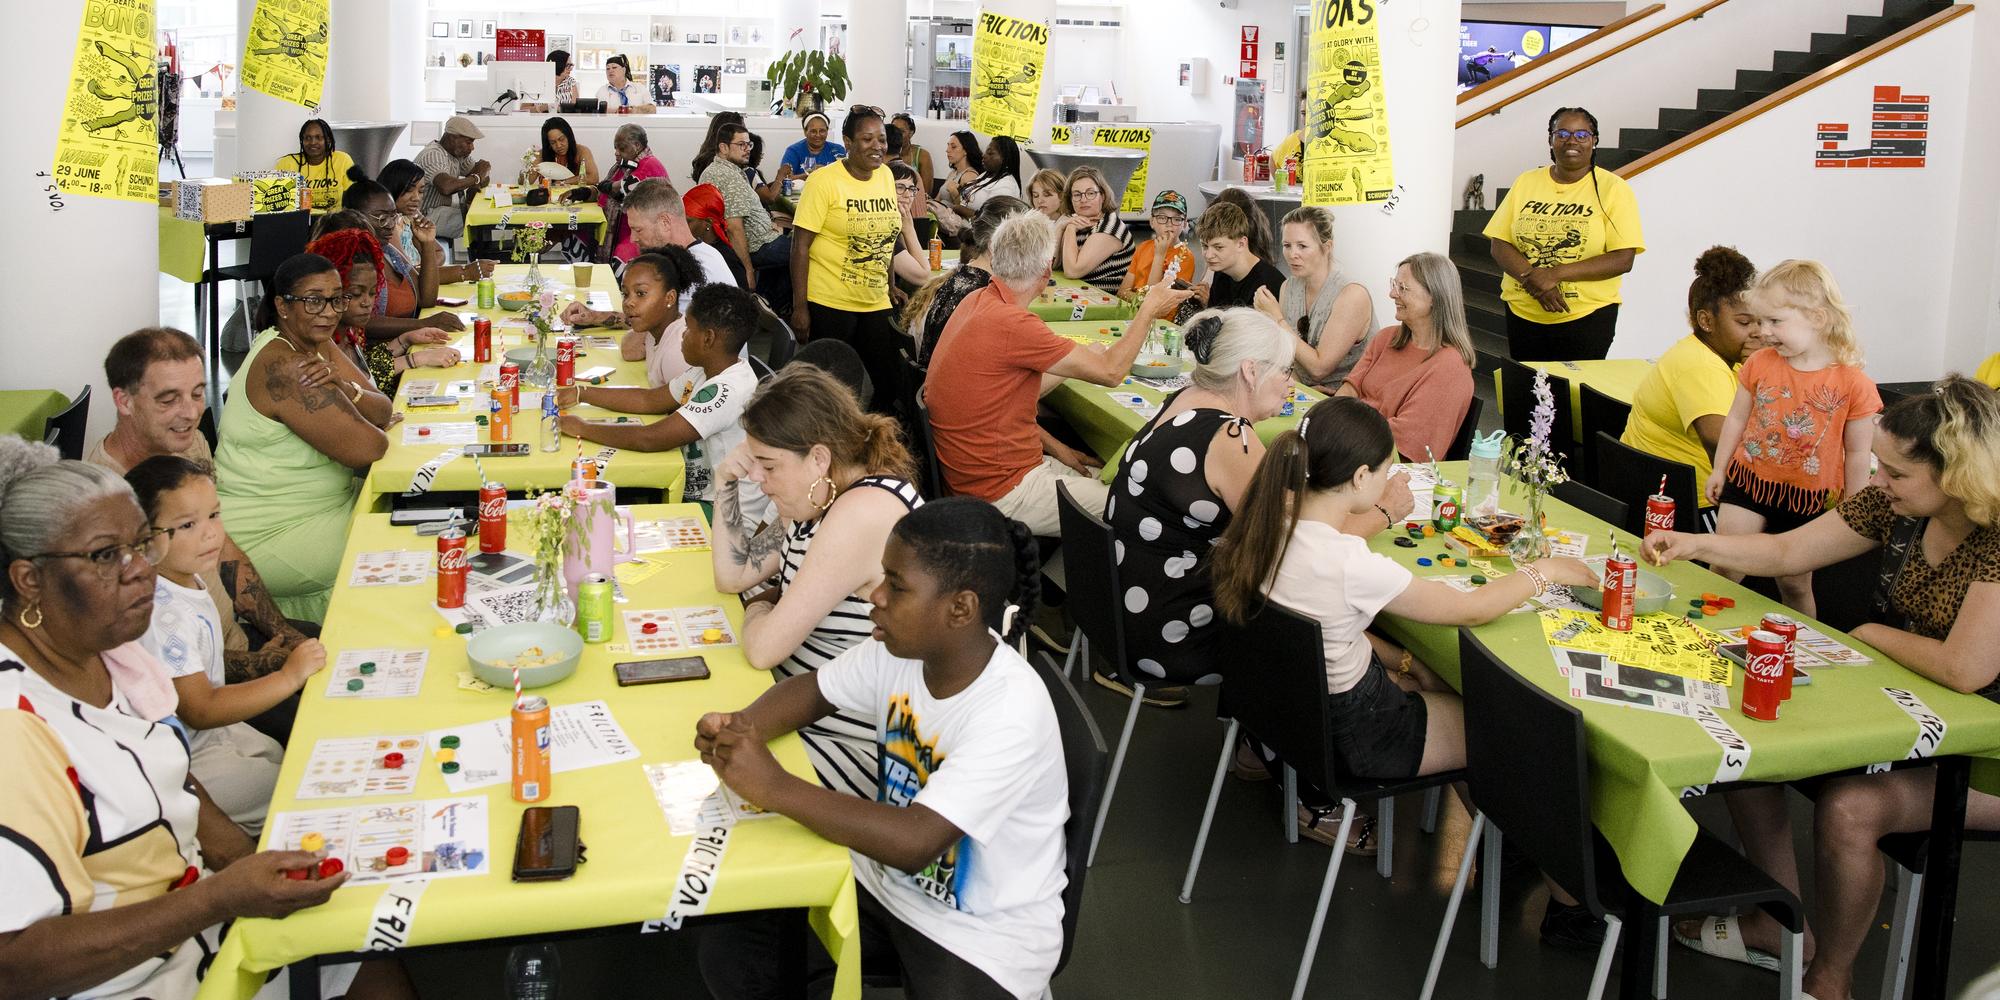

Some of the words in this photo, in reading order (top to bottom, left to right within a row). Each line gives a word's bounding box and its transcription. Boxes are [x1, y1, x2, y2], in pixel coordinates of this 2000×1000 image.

[978, 13, 1047, 46] FRICTIONS
[1334, 38, 1353, 47] GLORY
[1355, 36, 1374, 45] WITH
[271, 82, 294, 94] SCHUNCK
[1326, 109, 1335, 118] TO
[1320, 120, 1335, 132] WON
[1094, 128, 1151, 144] FRICTIONS
[57, 165, 71, 175] 29
[74, 168, 101, 180] JUNE
[267, 186, 285, 196] GREAT
[1316, 182, 1343, 193] SCHUNCK
[262, 193, 282, 205] PRIZES
[283, 191, 291, 199] TO
[276, 200, 289, 210] WON
[1520, 200, 1594, 217] FRICTIONS
[1757, 676, 1775, 684] TASTE
